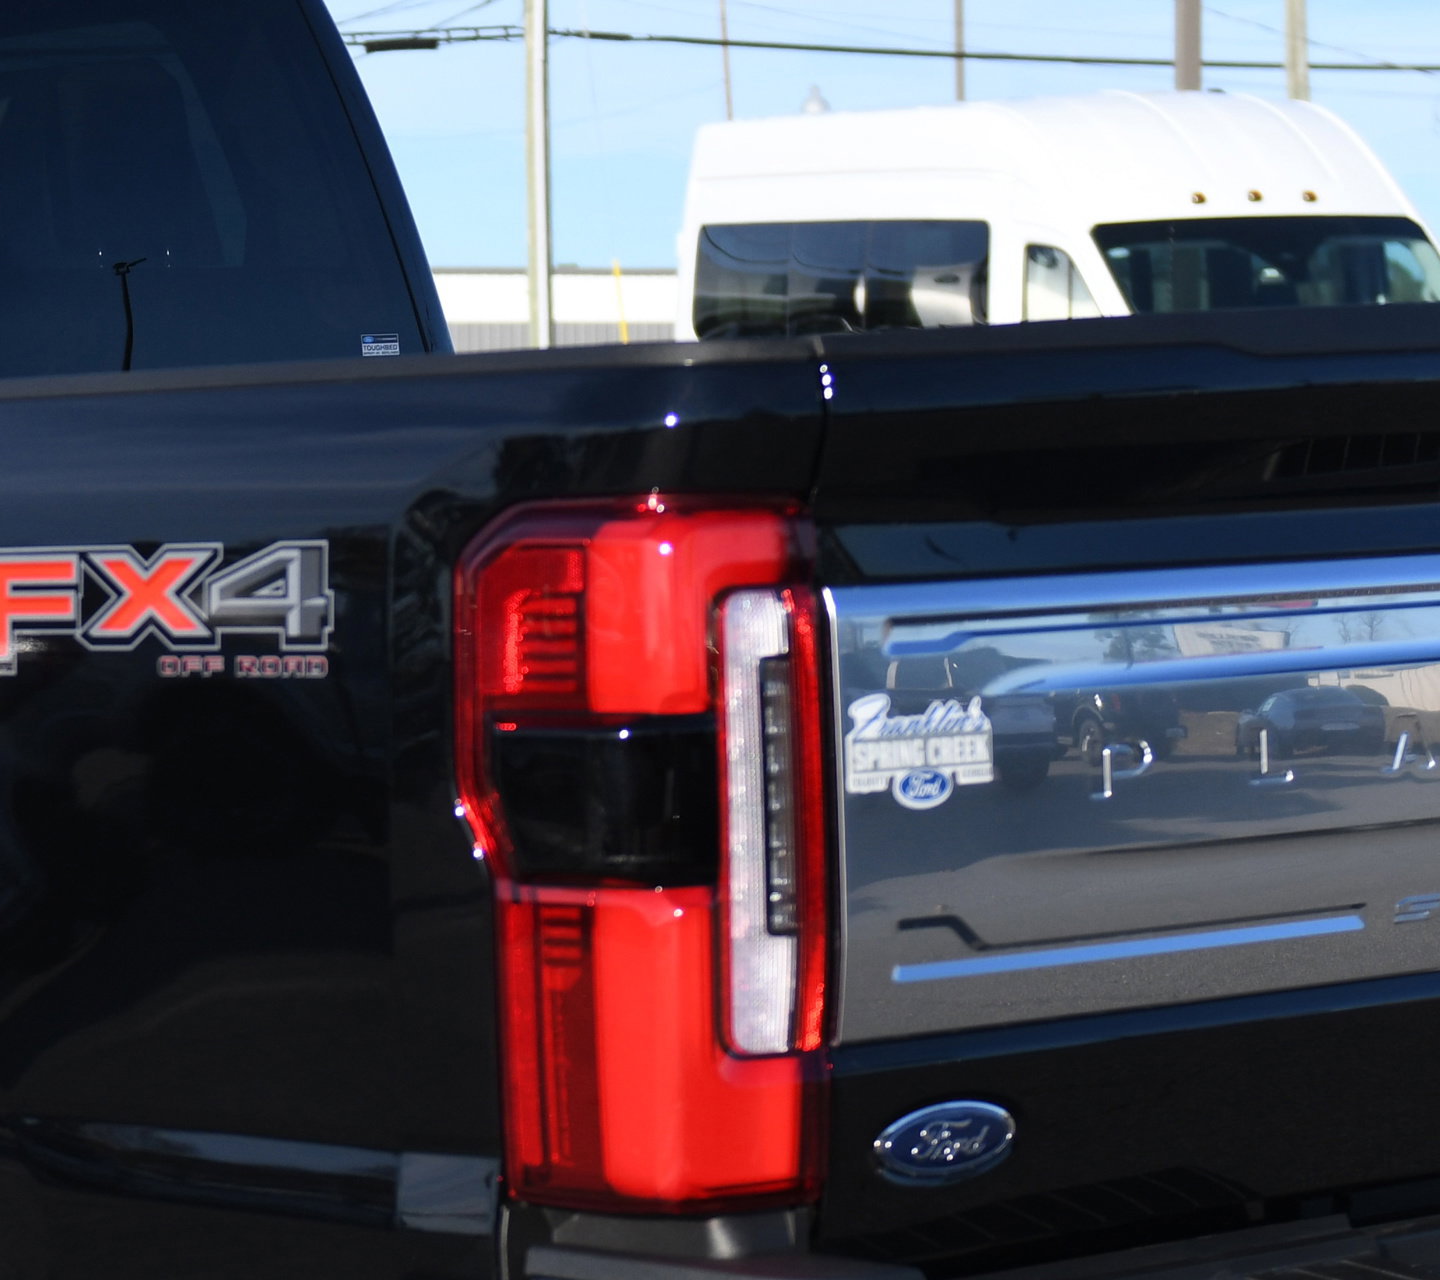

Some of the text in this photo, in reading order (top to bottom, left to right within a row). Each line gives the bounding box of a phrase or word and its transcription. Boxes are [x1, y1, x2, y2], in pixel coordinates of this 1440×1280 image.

[157, 654, 329, 679] OFF ROAD
[853, 733, 990, 773] SPRING CREEK
[909, 771, 942, 798] Ford
[910, 1118, 990, 1161] Ford
